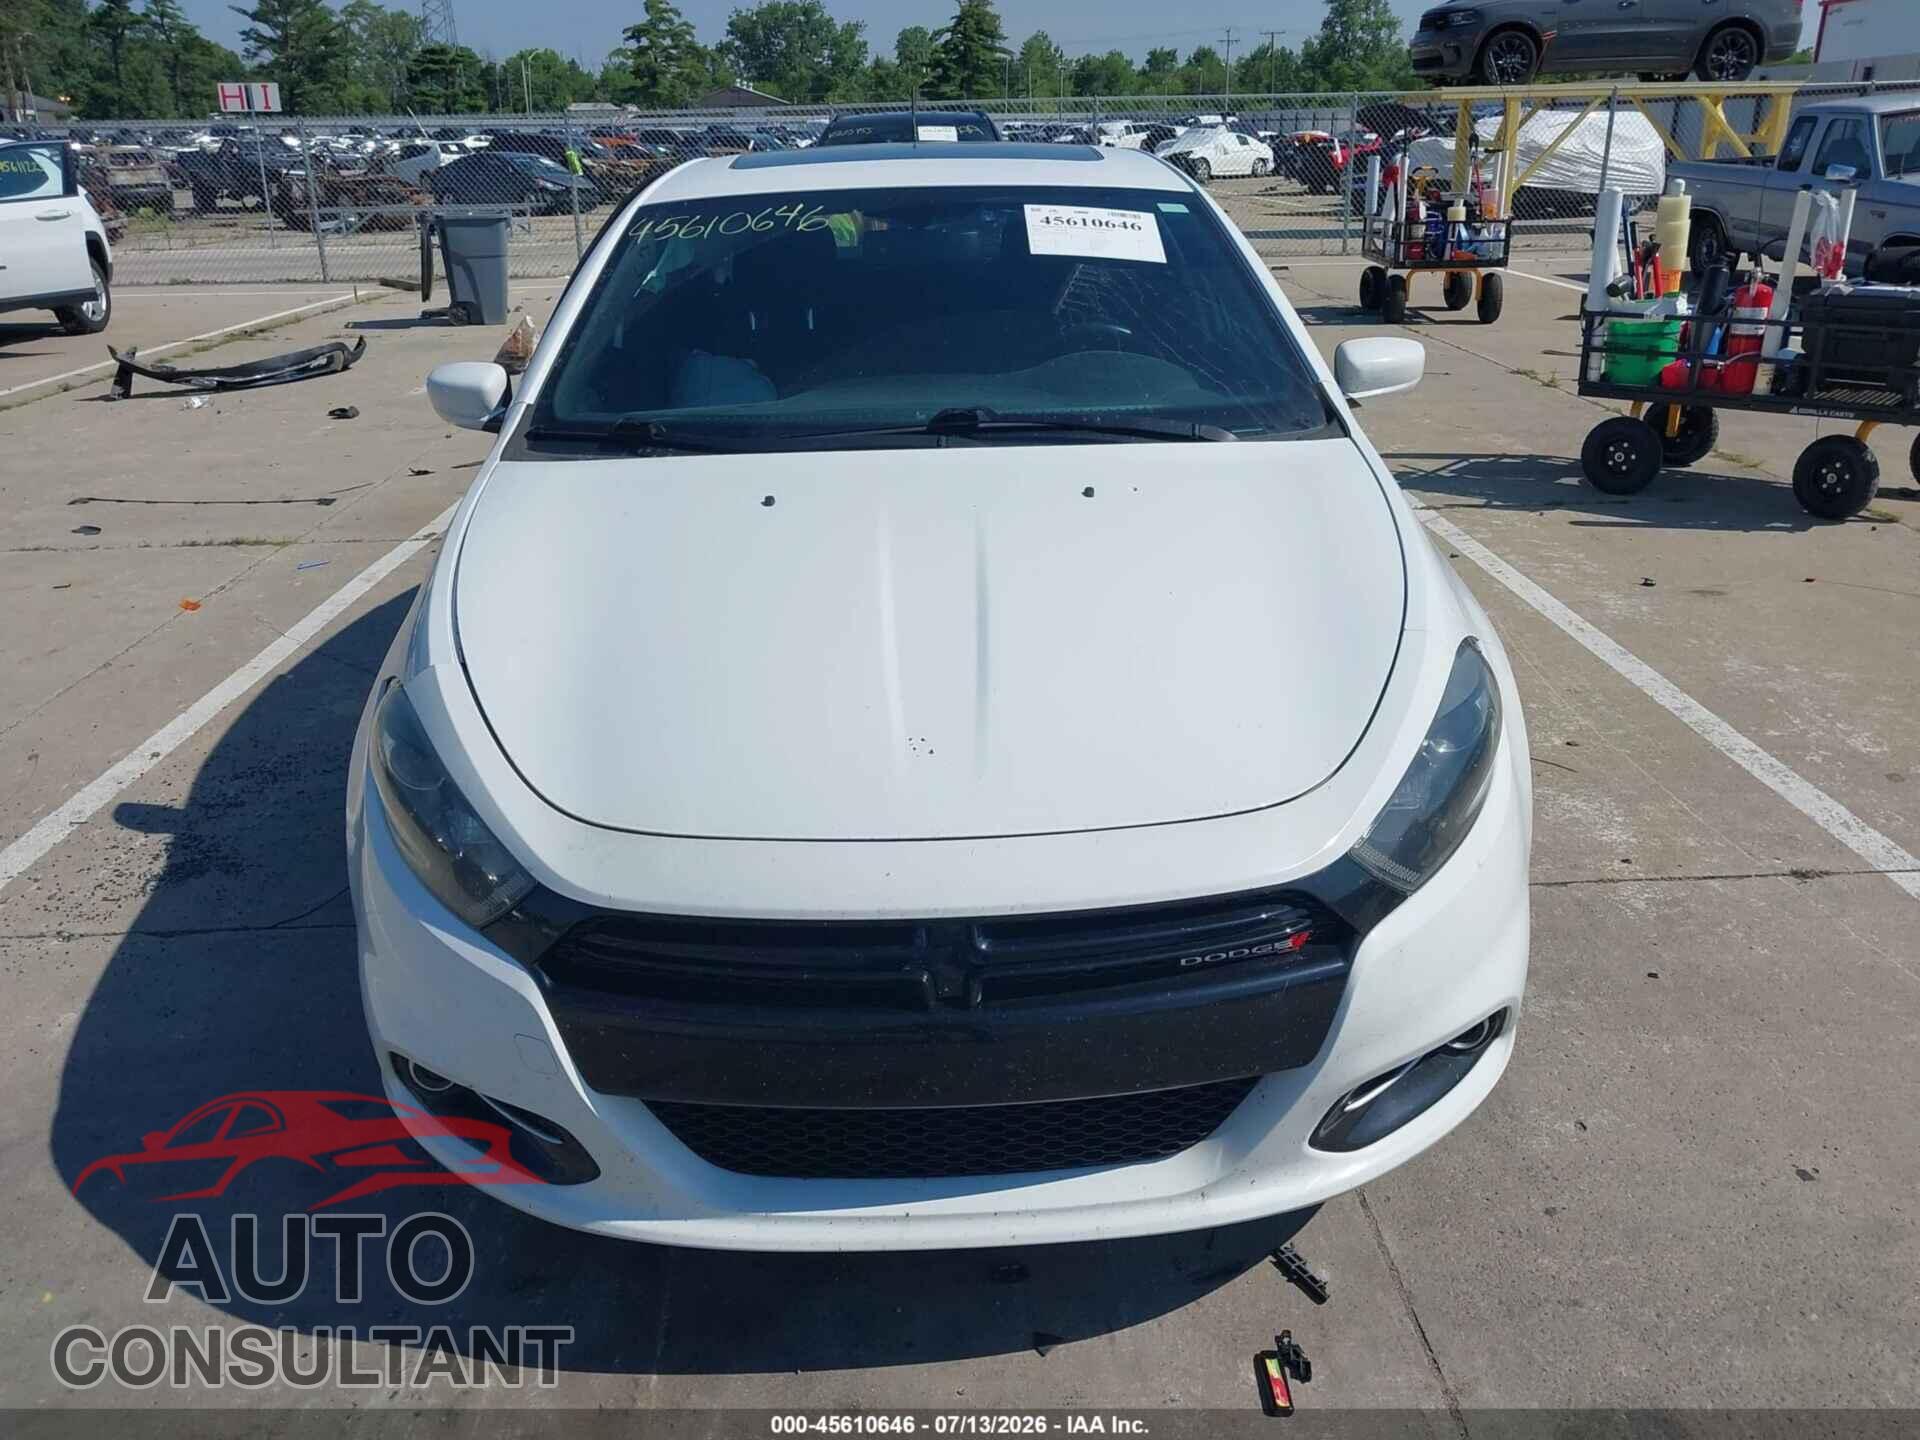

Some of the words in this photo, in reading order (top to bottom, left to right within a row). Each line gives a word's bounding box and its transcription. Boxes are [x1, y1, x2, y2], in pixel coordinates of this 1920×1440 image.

[628, 203, 830, 244] 45610646
[1040, 215, 1143, 232] 45610646
[1180, 940, 1293, 966] DODGE
